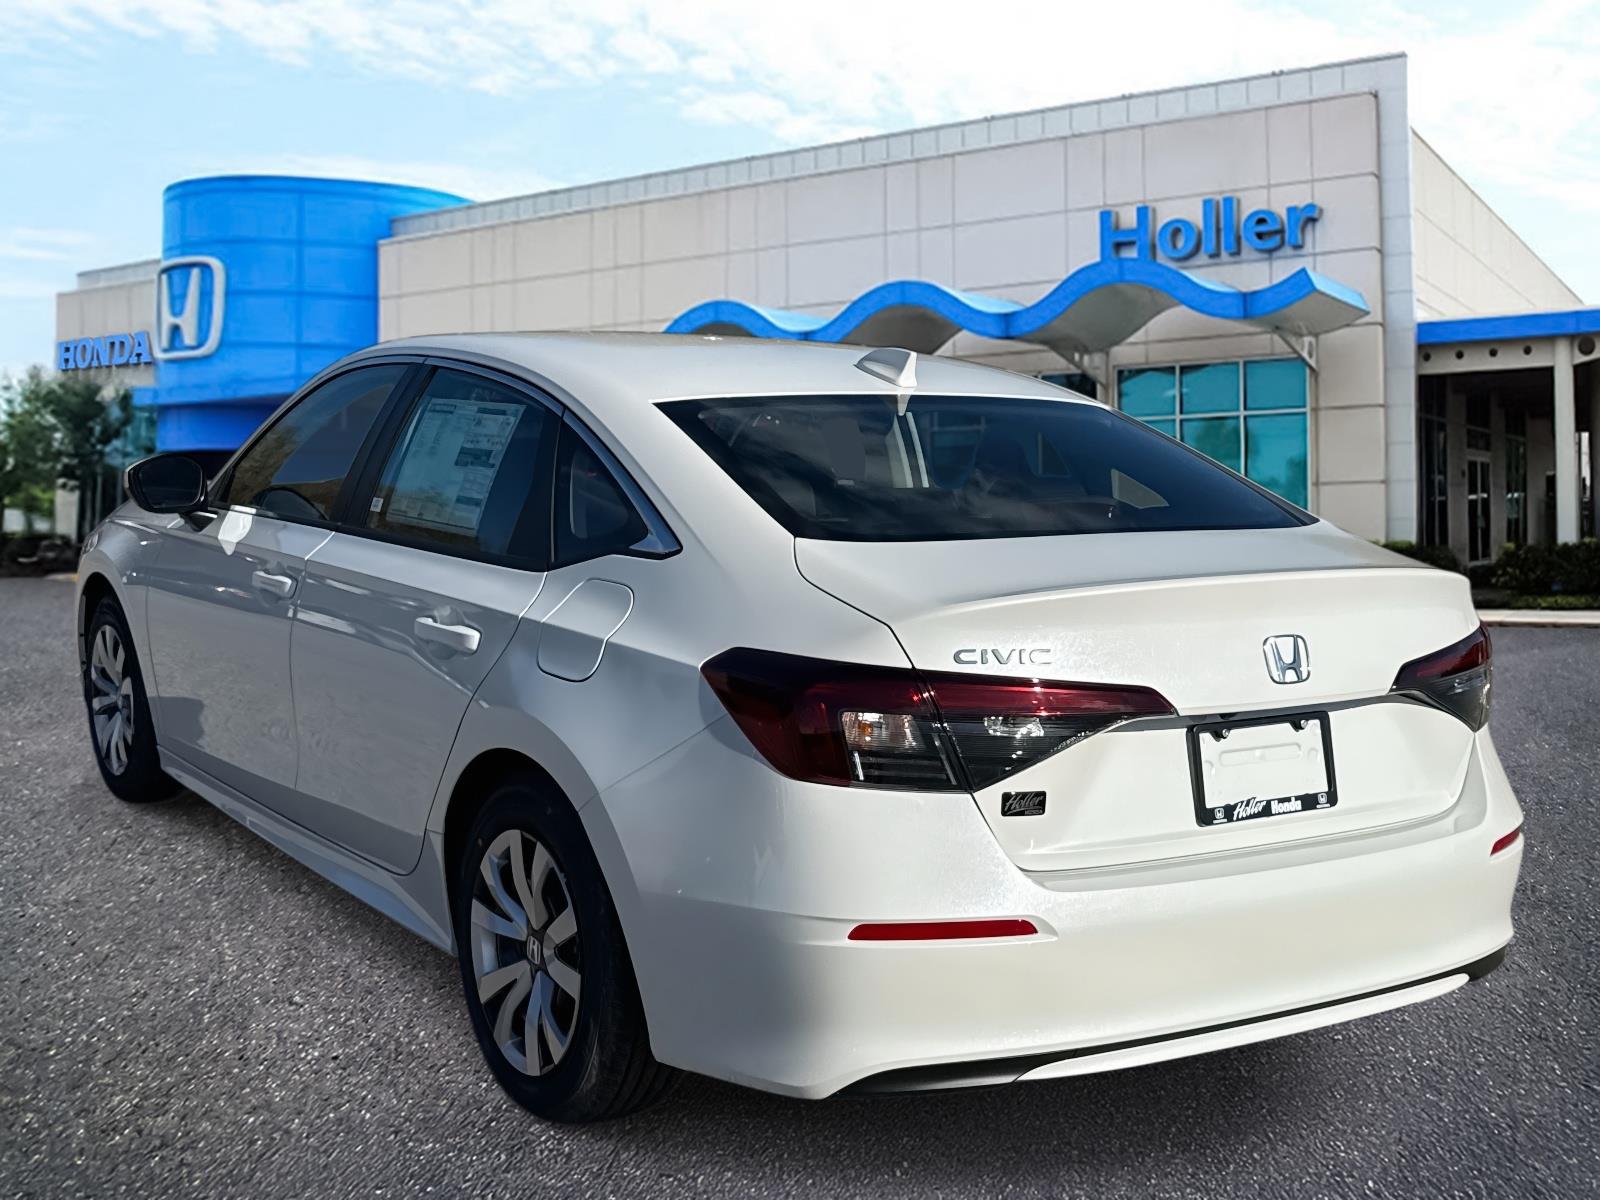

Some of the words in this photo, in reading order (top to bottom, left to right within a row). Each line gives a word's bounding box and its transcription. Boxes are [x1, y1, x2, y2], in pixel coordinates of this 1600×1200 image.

[1099, 195, 1322, 261] Holler
[58, 331, 153, 371] HONDA
[953, 648, 1053, 665] CIVIC
[1233, 797, 1267, 821] Holler
[1271, 797, 1302, 815] Honda
